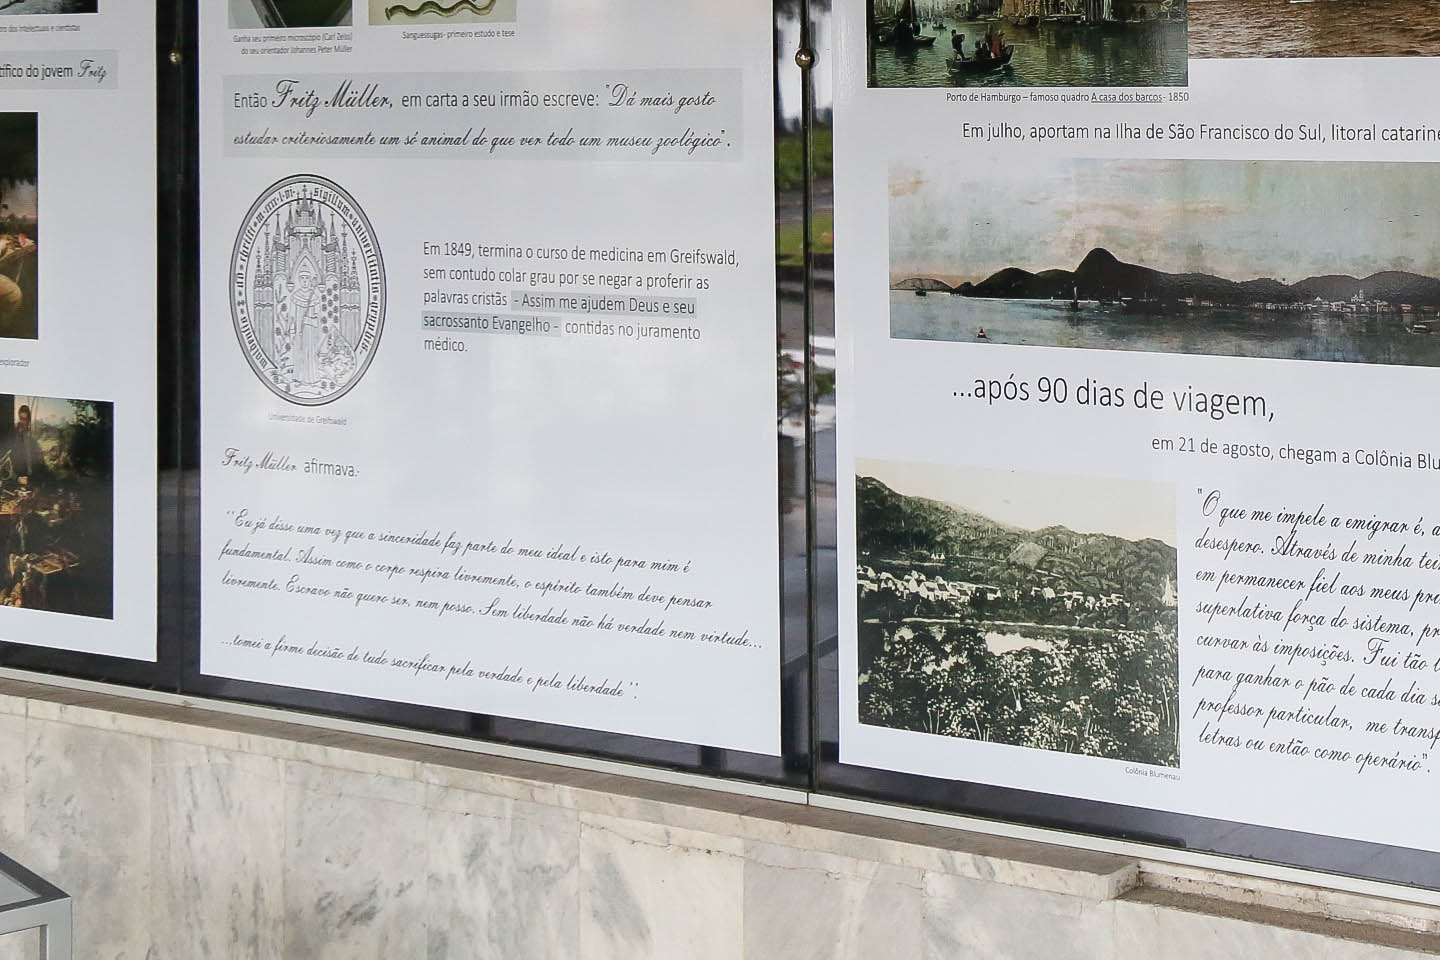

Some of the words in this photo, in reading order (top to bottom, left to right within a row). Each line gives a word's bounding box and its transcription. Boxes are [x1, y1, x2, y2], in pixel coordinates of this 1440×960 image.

[26, 64, 40, 77] do
[41, 64, 73, 80] jovem
[77, 59, 106, 82] Fritz
[234, 93, 267, 108] Então
[272, 80, 321, 118] Fritz
[325, 80, 392, 108] Müller,
[402, 96, 421, 107] em
[426, 93, 457, 107] carta
[462, 95, 468, 106] a
[473, 95, 495, 106] seu
[500, 90, 538, 106] irmão
[544, 94, 598, 106] escreve:
[640, 93, 674, 106] mais
[674, 92, 716, 114] gosto
[946, 93, 966, 102] Porto
[969, 93, 978, 101] de
[981, 93, 1021, 103] Hamburgo
[1030, 93, 1058, 101] famoso
[1061, 93, 1089, 103] quadro
[1092, 93, 1097, 101] A
[1119, 93, 1133, 101] dos
[1168, 93, 1189, 101] 1850
[963, 123, 983, 137] Em
[987, 123, 1025, 141] julho,
[1030, 125, 1088, 141] aportam
[1095, 128, 1110, 138] na
[1117, 123, 1140, 138] Ilha
[1146, 124, 1163, 139] de
[1169, 124, 1194, 139] São
[1200, 124, 1269, 140] Francisco
[1275, 124, 1293, 140] do
[1299, 124, 1325, 142] Sul,
[1332, 124, 1375, 140] litoral
[954, 380, 1029, 405] ...após
[1038, 377, 1067, 403] 90
[1077, 379, 1124, 407] dias
[1134, 382, 1163, 409] de
[1173, 386, 1274, 422] viagem,
[222, 448, 253, 474] Fritz
[256, 452, 296, 471] Müller
[1197, 636, 1249, 650] curvar
[1253, 634, 1270, 652] às
[1274, 638, 1354, 666] imposições.
[1363, 638, 1400, 667] Fui
[1403, 652, 1428, 670] tão
